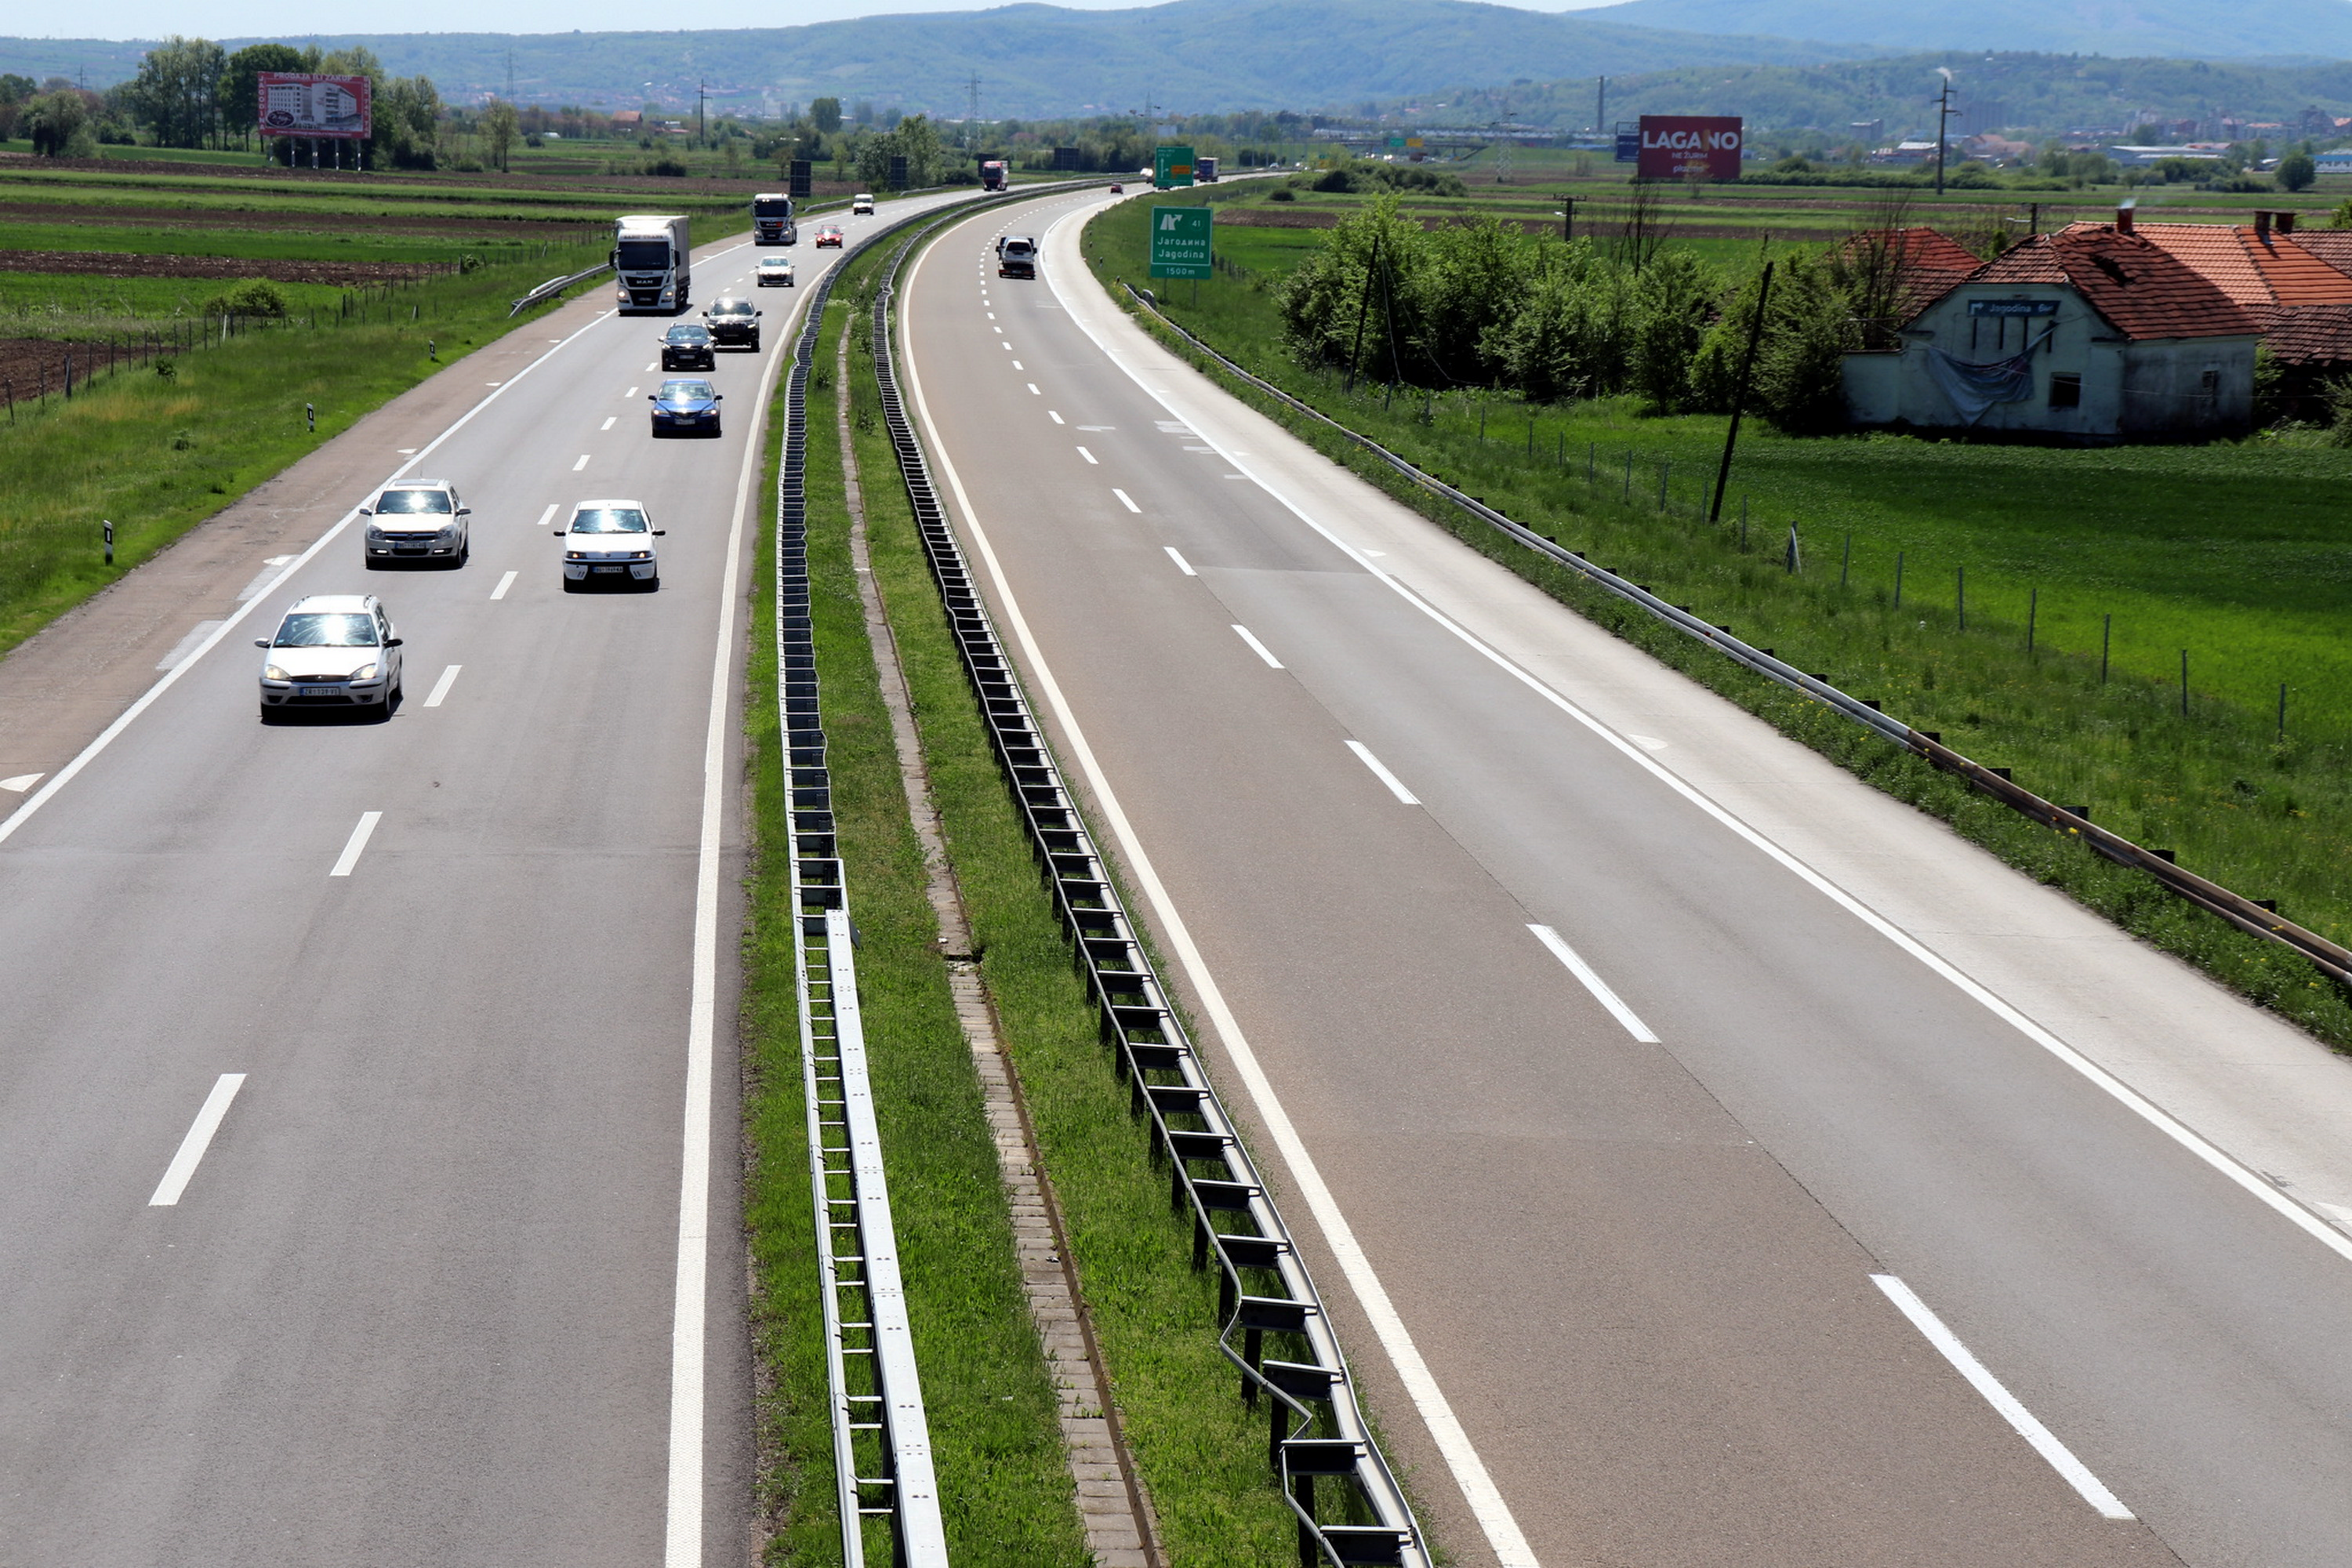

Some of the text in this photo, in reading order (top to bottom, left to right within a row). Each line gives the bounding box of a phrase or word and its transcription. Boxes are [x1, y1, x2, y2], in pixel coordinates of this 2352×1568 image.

[1642, 130, 1740, 150] LAGANO
[1157, 237, 1206, 246] Јагодина
[1158, 249, 1204, 260] Jagodina
[1990, 303, 2032, 314] Jagodina
